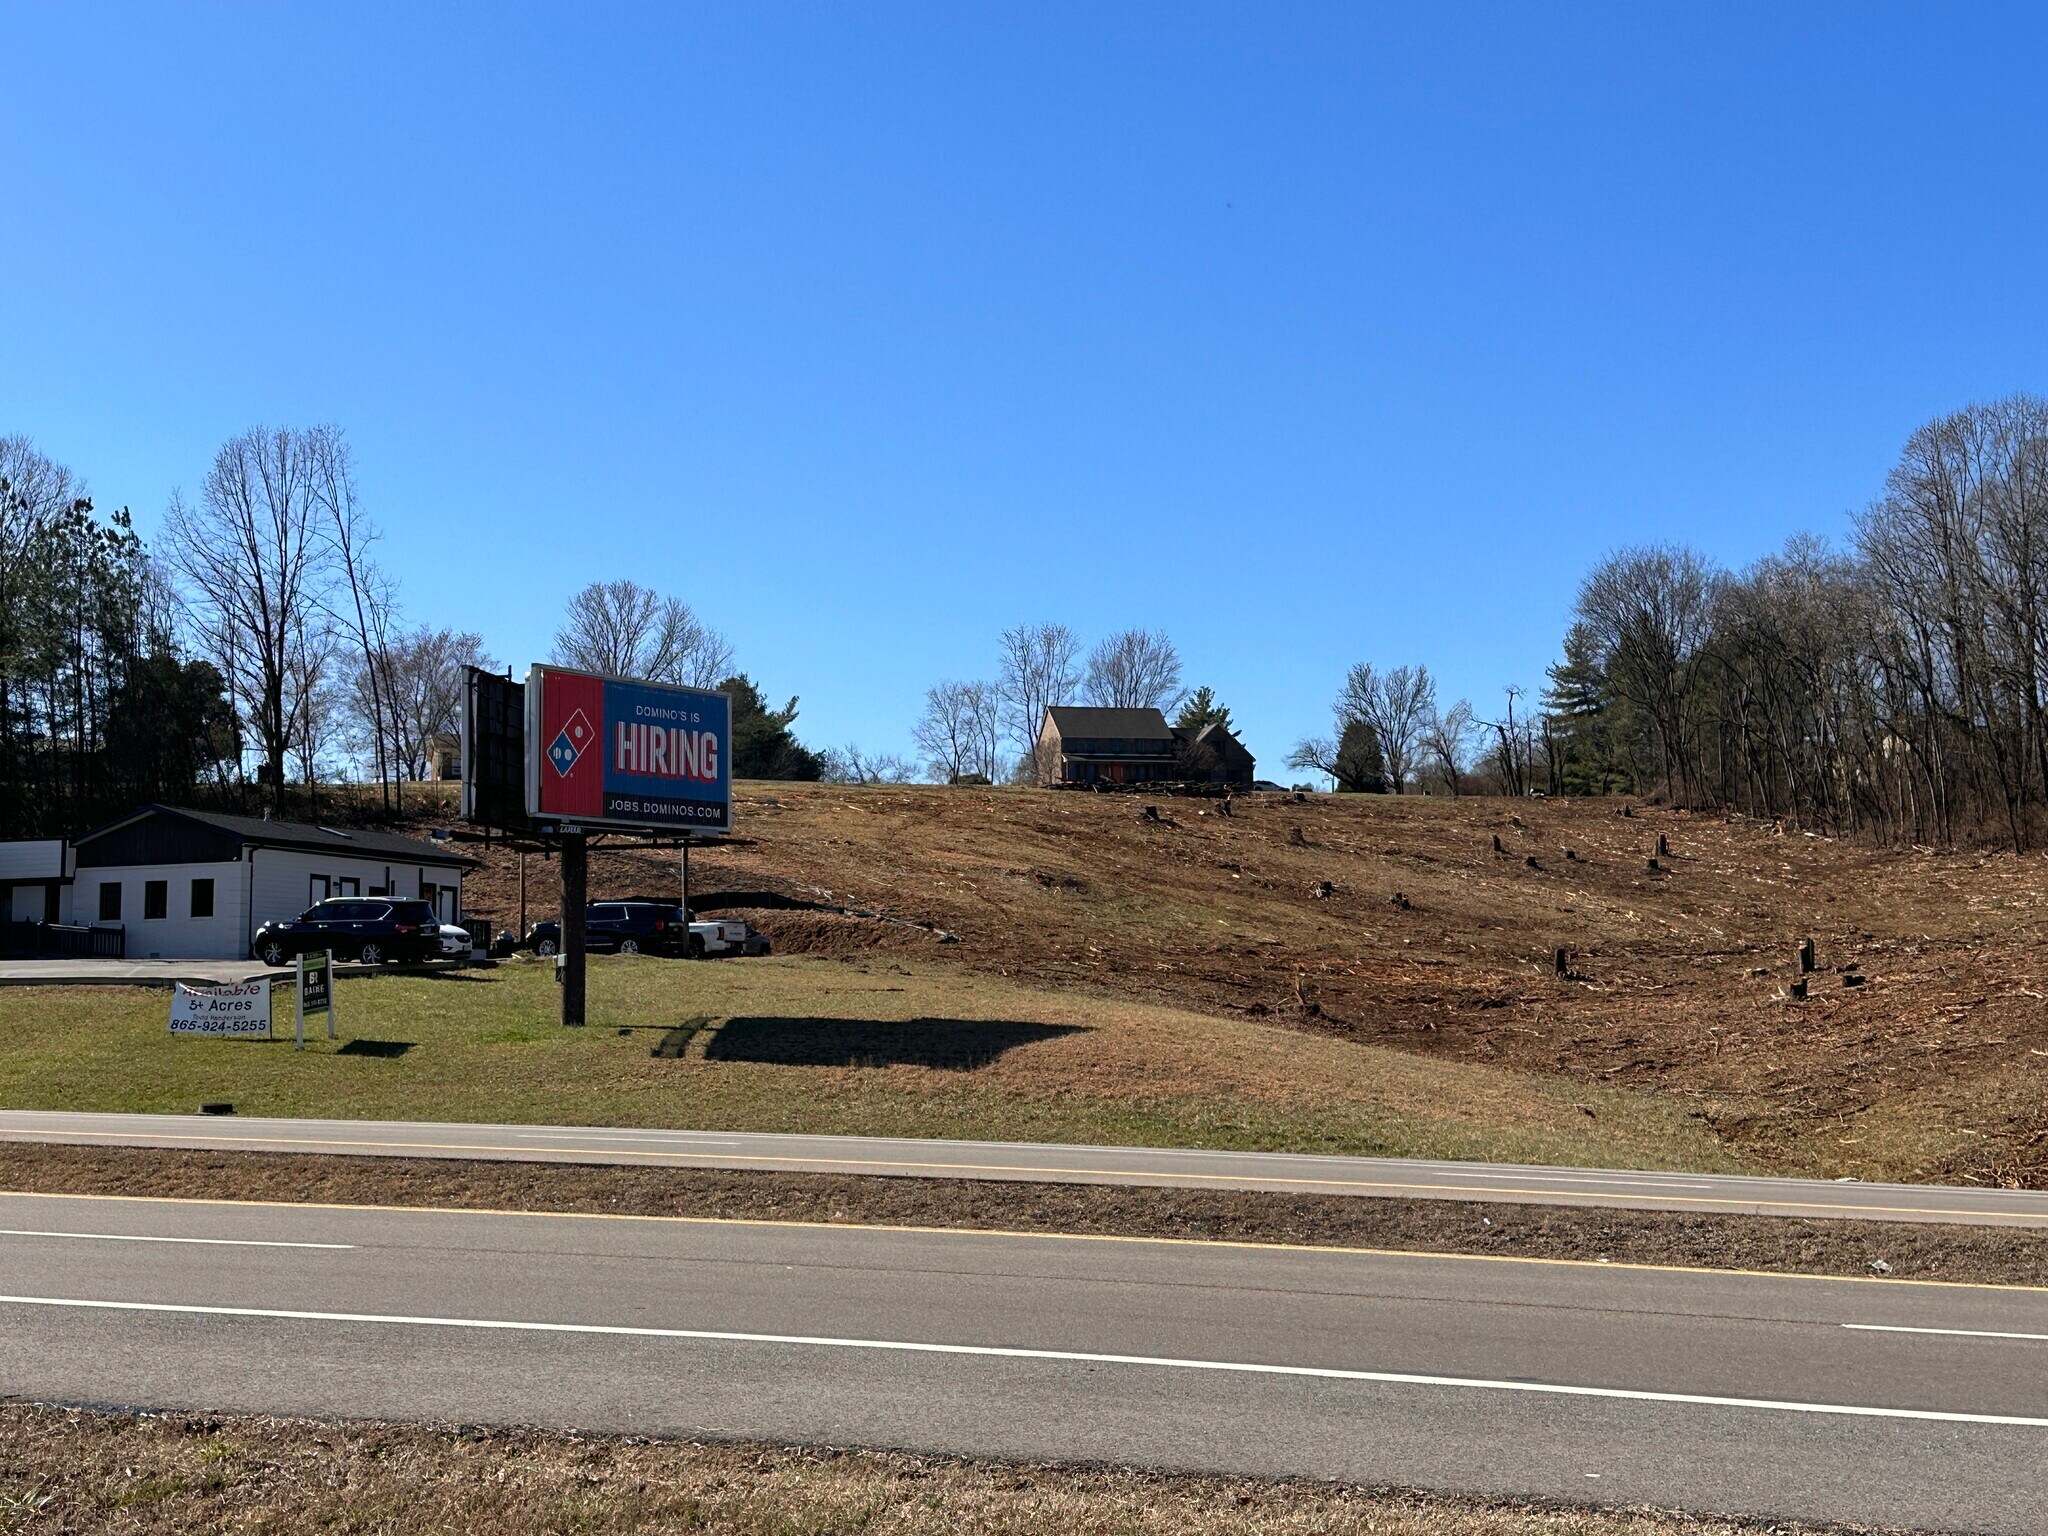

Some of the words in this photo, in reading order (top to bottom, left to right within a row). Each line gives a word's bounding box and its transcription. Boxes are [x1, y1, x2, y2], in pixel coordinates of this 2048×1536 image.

[636, 705, 687, 722] DOMINO'S
[690, 712, 700, 723] IS
[615, 721, 718, 782] HIRING
[608, 799, 721, 818] JOBS.DOMINOS.COM
[188, 1000, 204, 1011] 5+
[208, 999, 253, 1012] Acres
[170, 1019, 267, 1032] 865-924-5255
